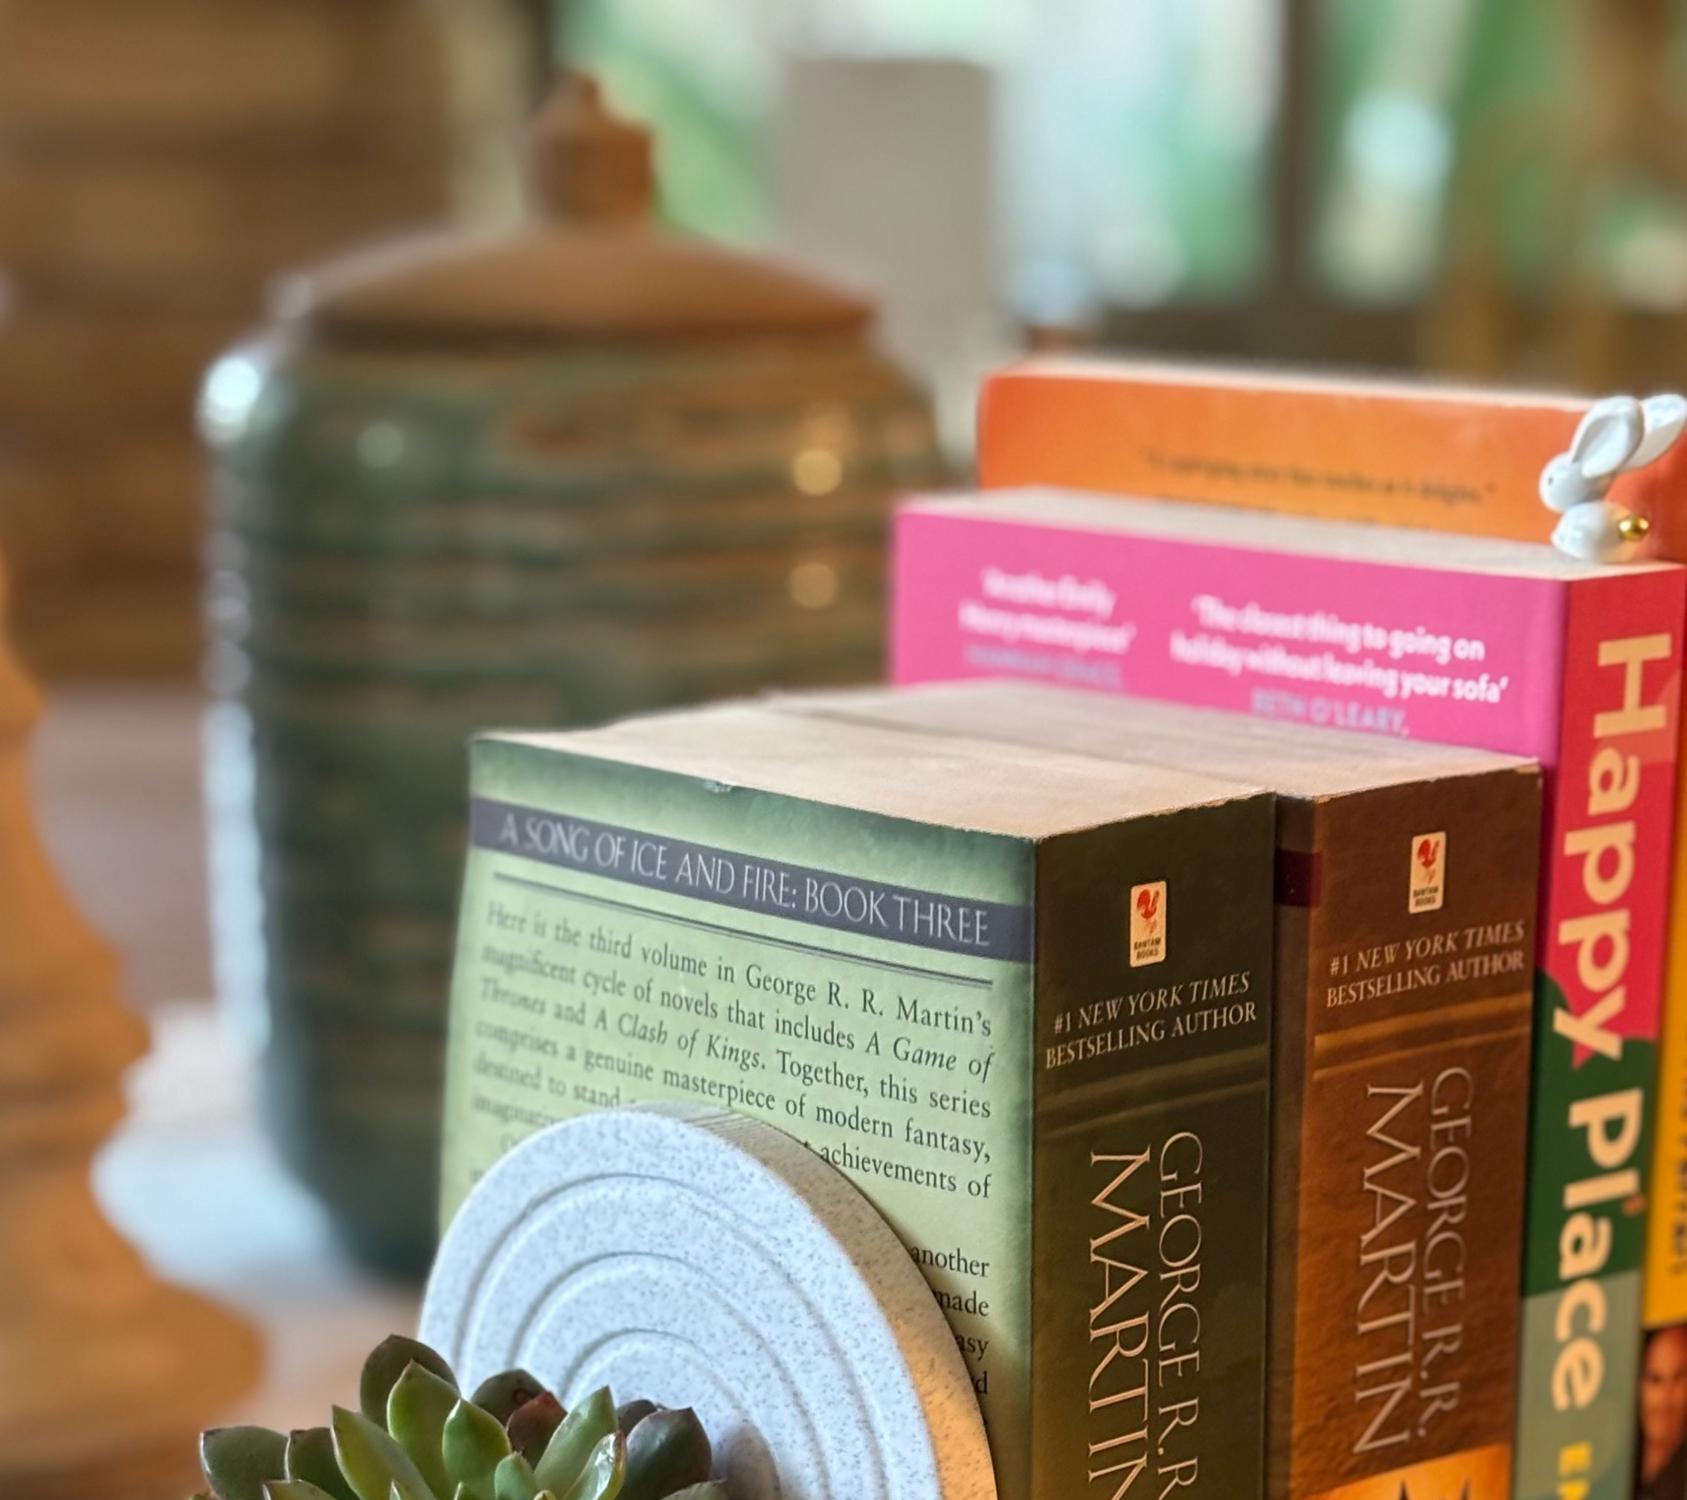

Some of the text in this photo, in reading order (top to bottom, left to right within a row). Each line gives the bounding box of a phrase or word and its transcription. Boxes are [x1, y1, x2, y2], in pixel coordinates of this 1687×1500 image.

[1170, 629, 1509, 703] holiday without leaving your sofa'
[1306, 612, 1360, 655] thing
[1362, 623, 1387, 650] to
[1388, 626, 1450, 665] going
[1453, 638, 1485, 661] on
[500, 812, 992, 947] A SONG OF ICE AND FIRE: BOOK THREE
[487, 901, 992, 1038] Here is the third volume in George R. R. Martin's
[1054, 970, 1251, 1035] #1 NEW YORK TIMES
[1326, 951, 1525, 1009] BESTSELLING AUTHOR
[1330, 920, 1526, 977] #1 NEW YORK TIMES
[554, 1001, 587, 1027] and
[594, 1008, 609, 1032] A
[618, 1011, 669, 1046] Clash
[677, 1028, 700, 1059] of
[706, 1033, 766, 1073] Kings.
[776, 1048, 869, 1098] Together,
[880, 1074, 918, 1105] this
[929, 1089, 992, 1119] series
[583, 968, 627, 998] cycle
[634, 978, 654, 1003] of
[661, 989, 719, 1020] novels
[728, 999, 765, 1031] that
[775, 1009, 855, 1051] includes
[865, 1031, 880, 1056] A
[893, 1036, 957, 1072] Game
[968, 1051, 995, 1084] of
[1045, 1001, 1257, 1071] BESTSELLING AUTHOR
[1551, 633, 1672, 1411] Happy Place
[549, 1076, 567, 1097] to
[571, 1084, 622, 1108] stand
[820, 1142, 957, 1193] achievements
[967, 1173, 992, 1199] of
[565, 1045, 577, 1062] a
[584, 1049, 654, 1083] genuine
[662, 1069, 776, 1111] masterpiece
[785, 1092, 807, 1118] of
[816, 1104, 894, 1138] modern
[904, 1117, 992, 1164] fantasy,
[1422, 1067, 1476, 1315] GEORGE
[911, 1245, 990, 1278] another
[1158, 1130, 1204, 1388] GEORGE
[1353, 1080, 1424, 1453] MARTIN
